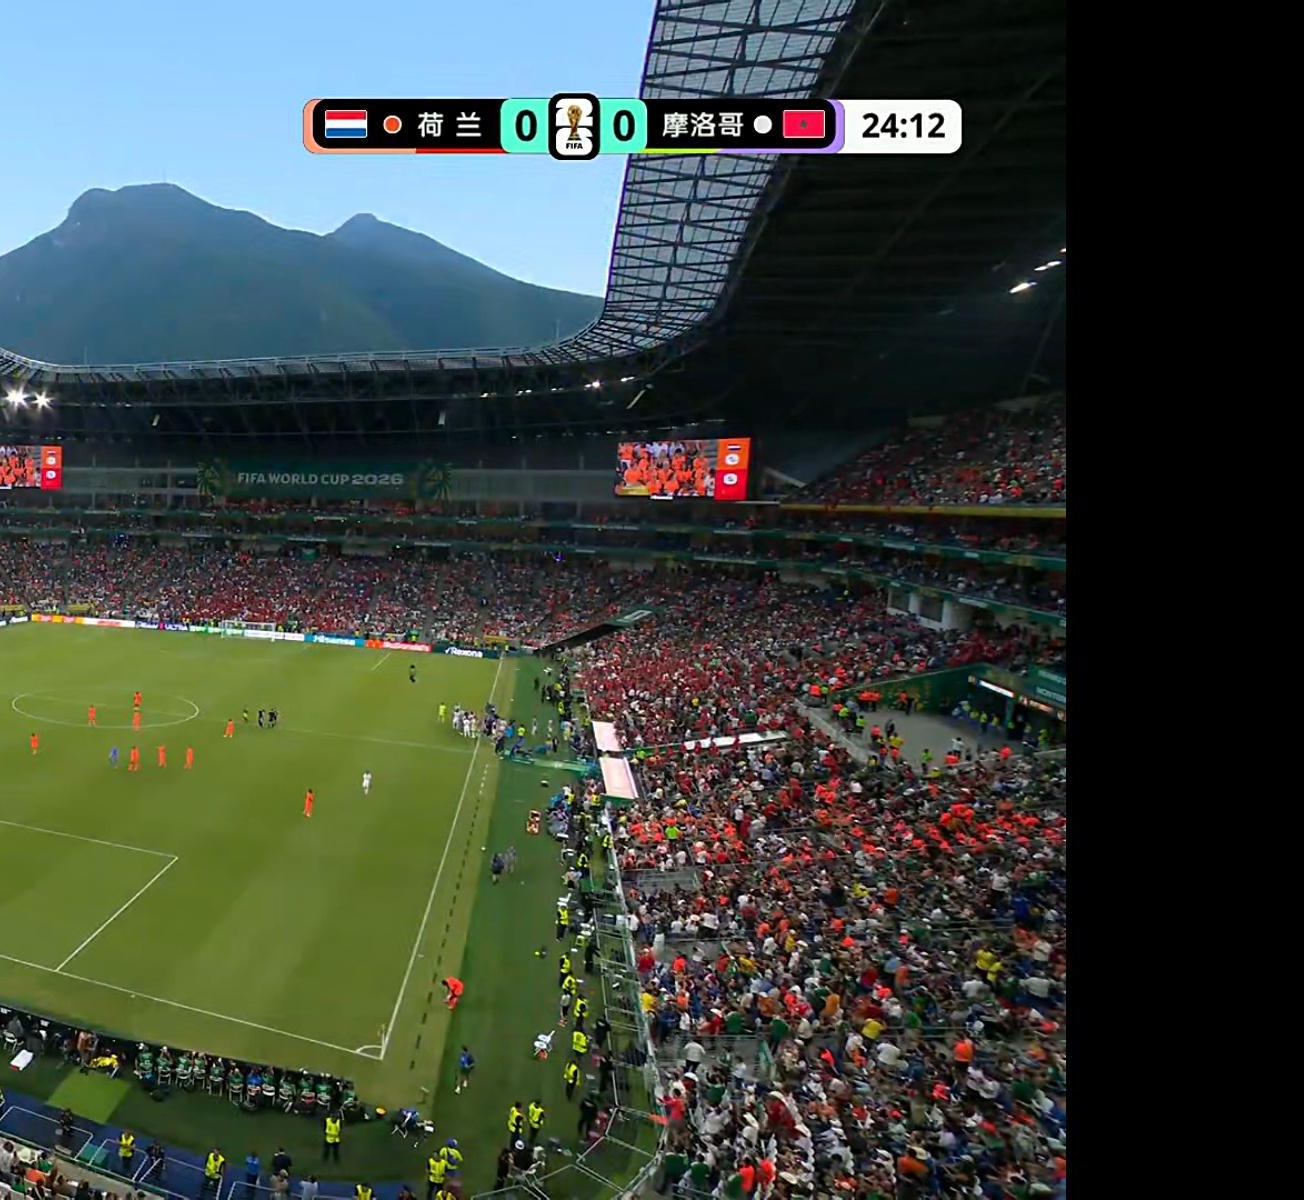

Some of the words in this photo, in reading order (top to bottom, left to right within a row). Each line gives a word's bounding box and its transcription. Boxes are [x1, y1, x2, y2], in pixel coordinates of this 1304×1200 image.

[237, 472, 265, 484] FIFA
[268, 473, 318, 485] WORLD
[320, 474, 349, 485] CUP
[351, 474, 404, 486] 2026
